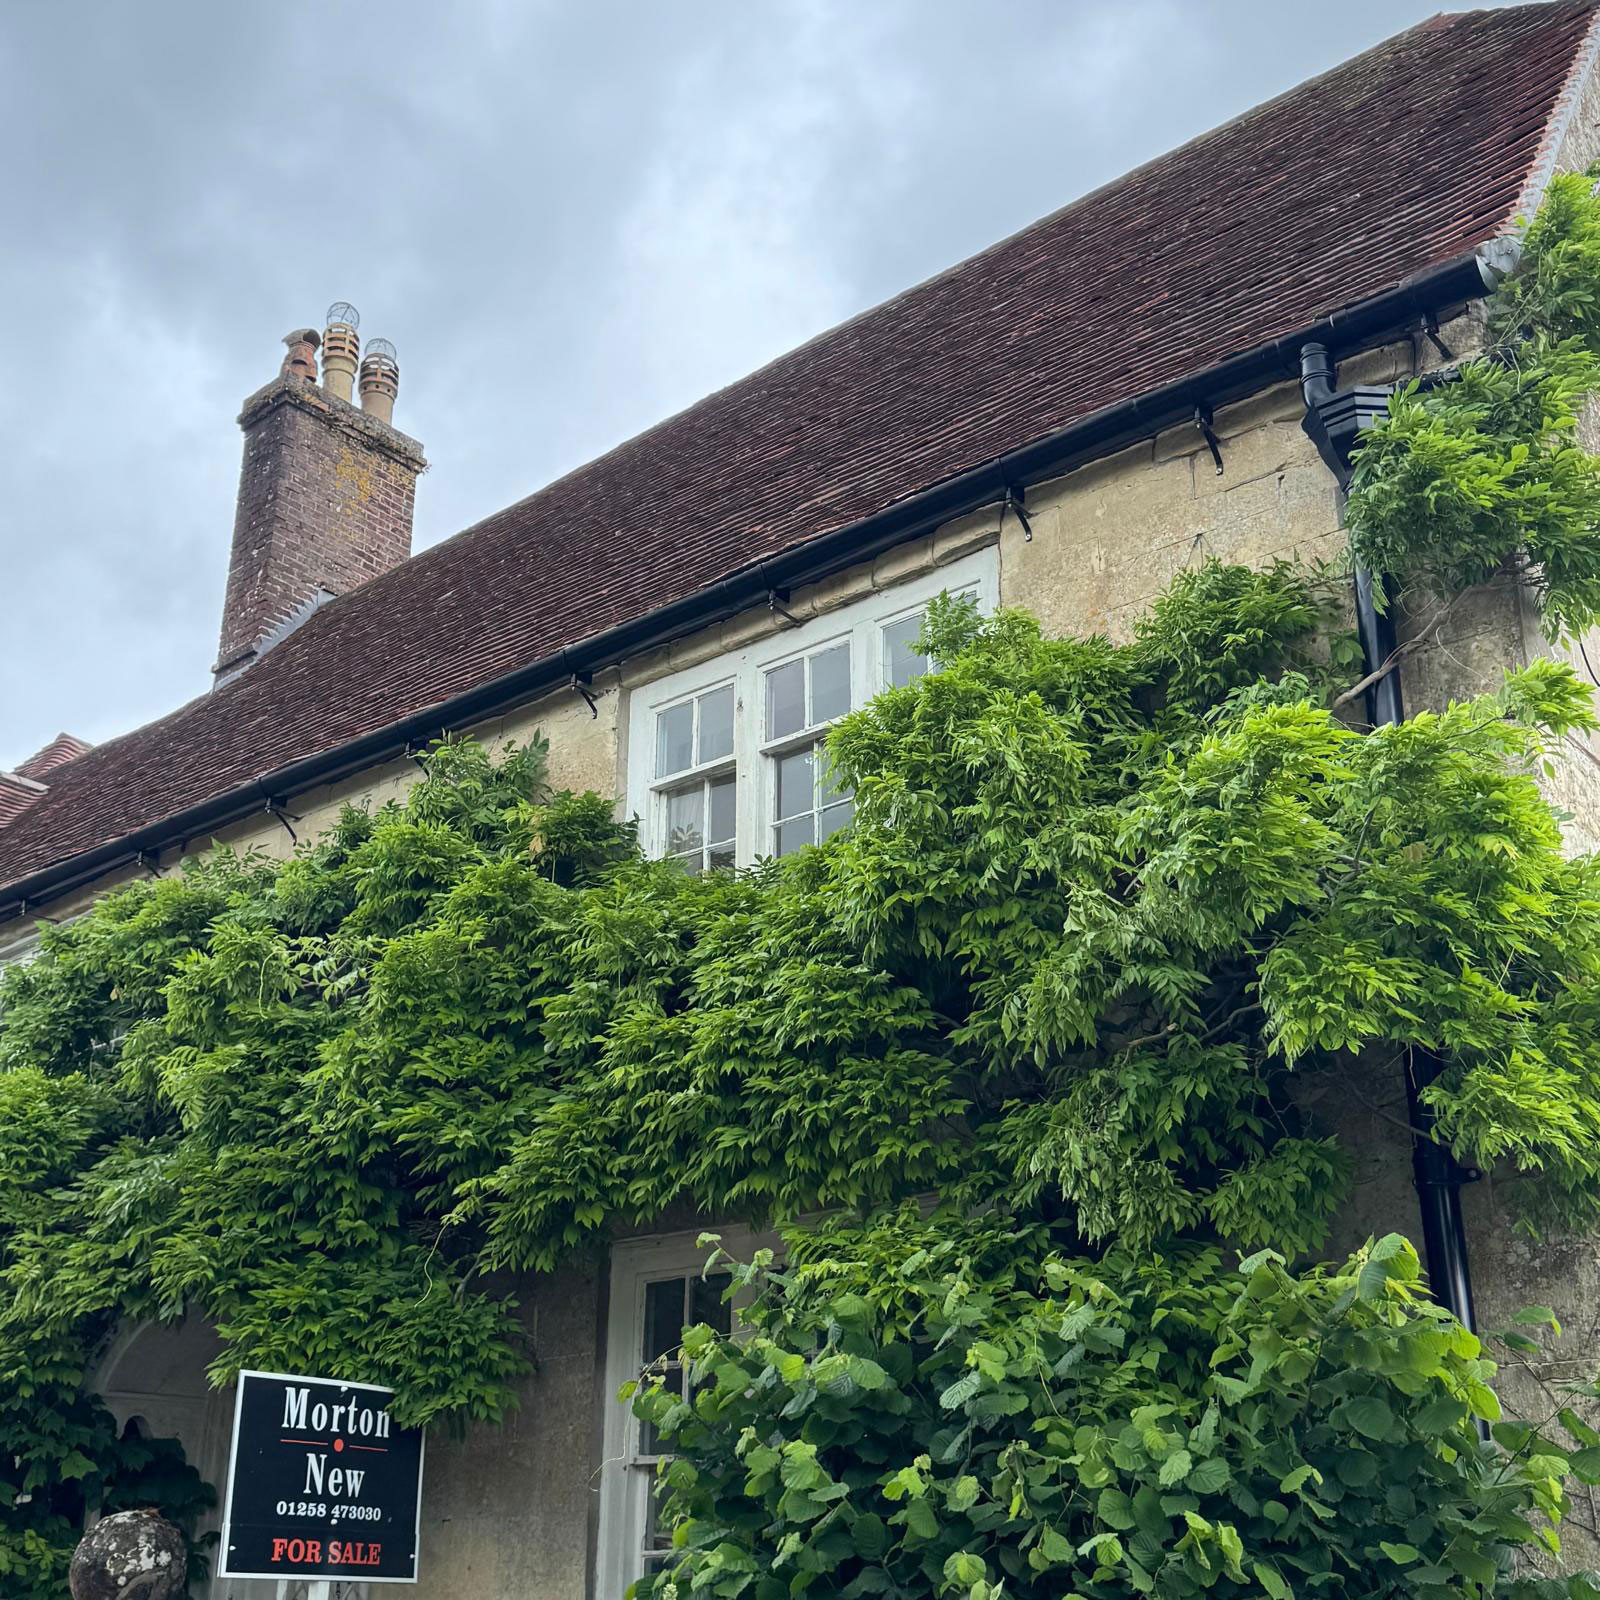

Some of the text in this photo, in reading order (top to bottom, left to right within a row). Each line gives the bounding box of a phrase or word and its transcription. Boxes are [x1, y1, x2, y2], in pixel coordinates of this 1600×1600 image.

[281, 1386, 390, 1438] Morton
[303, 1453, 365, 1498] New
[276, 1501, 382, 1521] 01258 473030
[271, 1538, 381, 1565] FOR SALE
